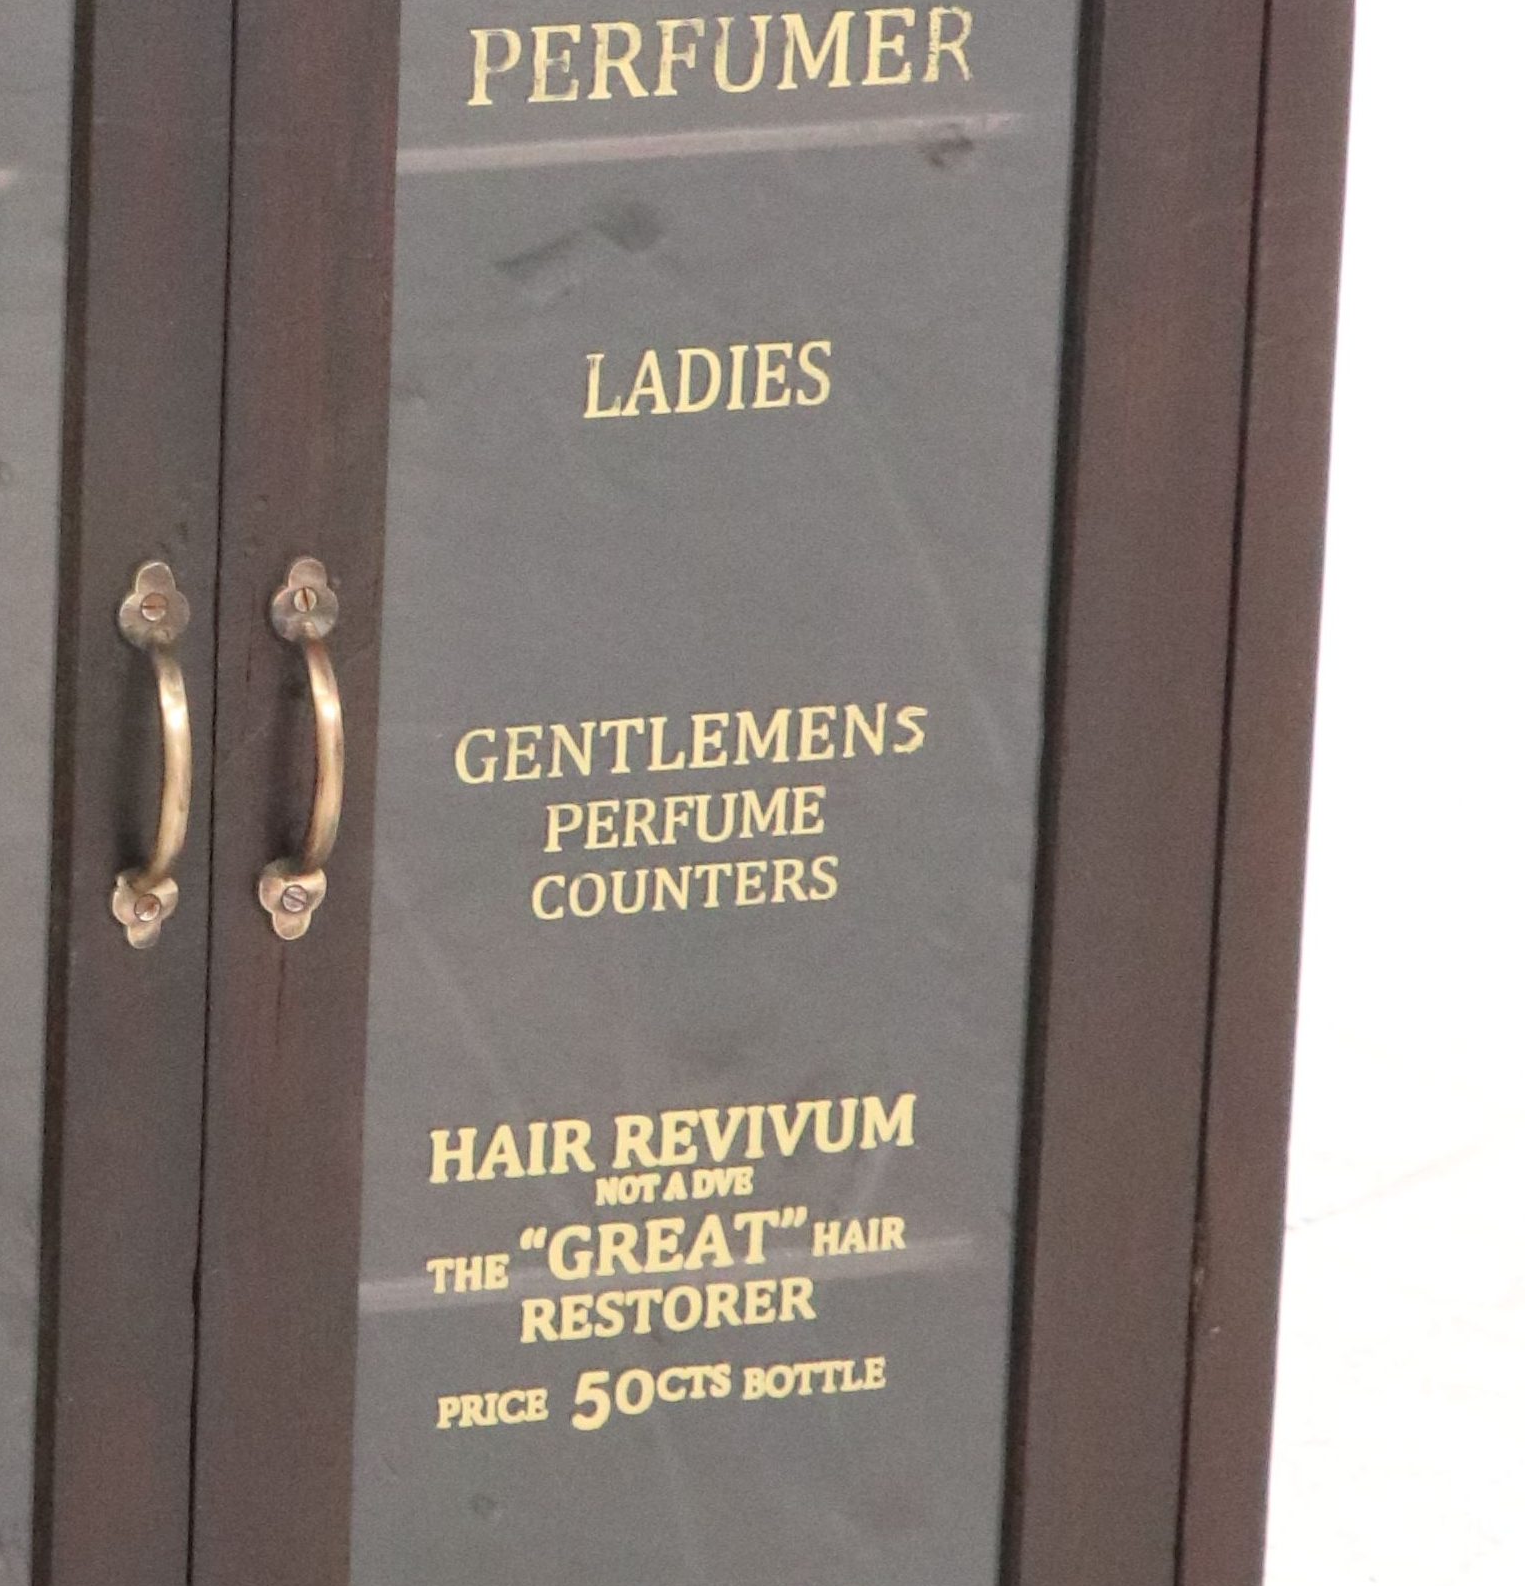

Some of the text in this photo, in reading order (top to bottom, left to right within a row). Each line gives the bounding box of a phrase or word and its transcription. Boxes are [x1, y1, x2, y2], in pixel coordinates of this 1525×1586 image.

[465, 4, 974, 108] PERFUMER
[582, 338, 833, 420] LADIES
[453, 700, 930, 785] GENTLEMENS
[542, 783, 827, 854] PERFUME
[529, 853, 840, 921] COUNTERS
[428, 1090, 918, 1185] HAIR REVIVUM
[593, 1171, 663, 1208] NOT
[425, 1249, 511, 1295] THE
[809, 1213, 907, 1258] HAIR
[518, 1272, 818, 1345] RESTORER
[436, 1385, 550, 1431] PRICE
[740, 1353, 887, 1402] BOTTLE
